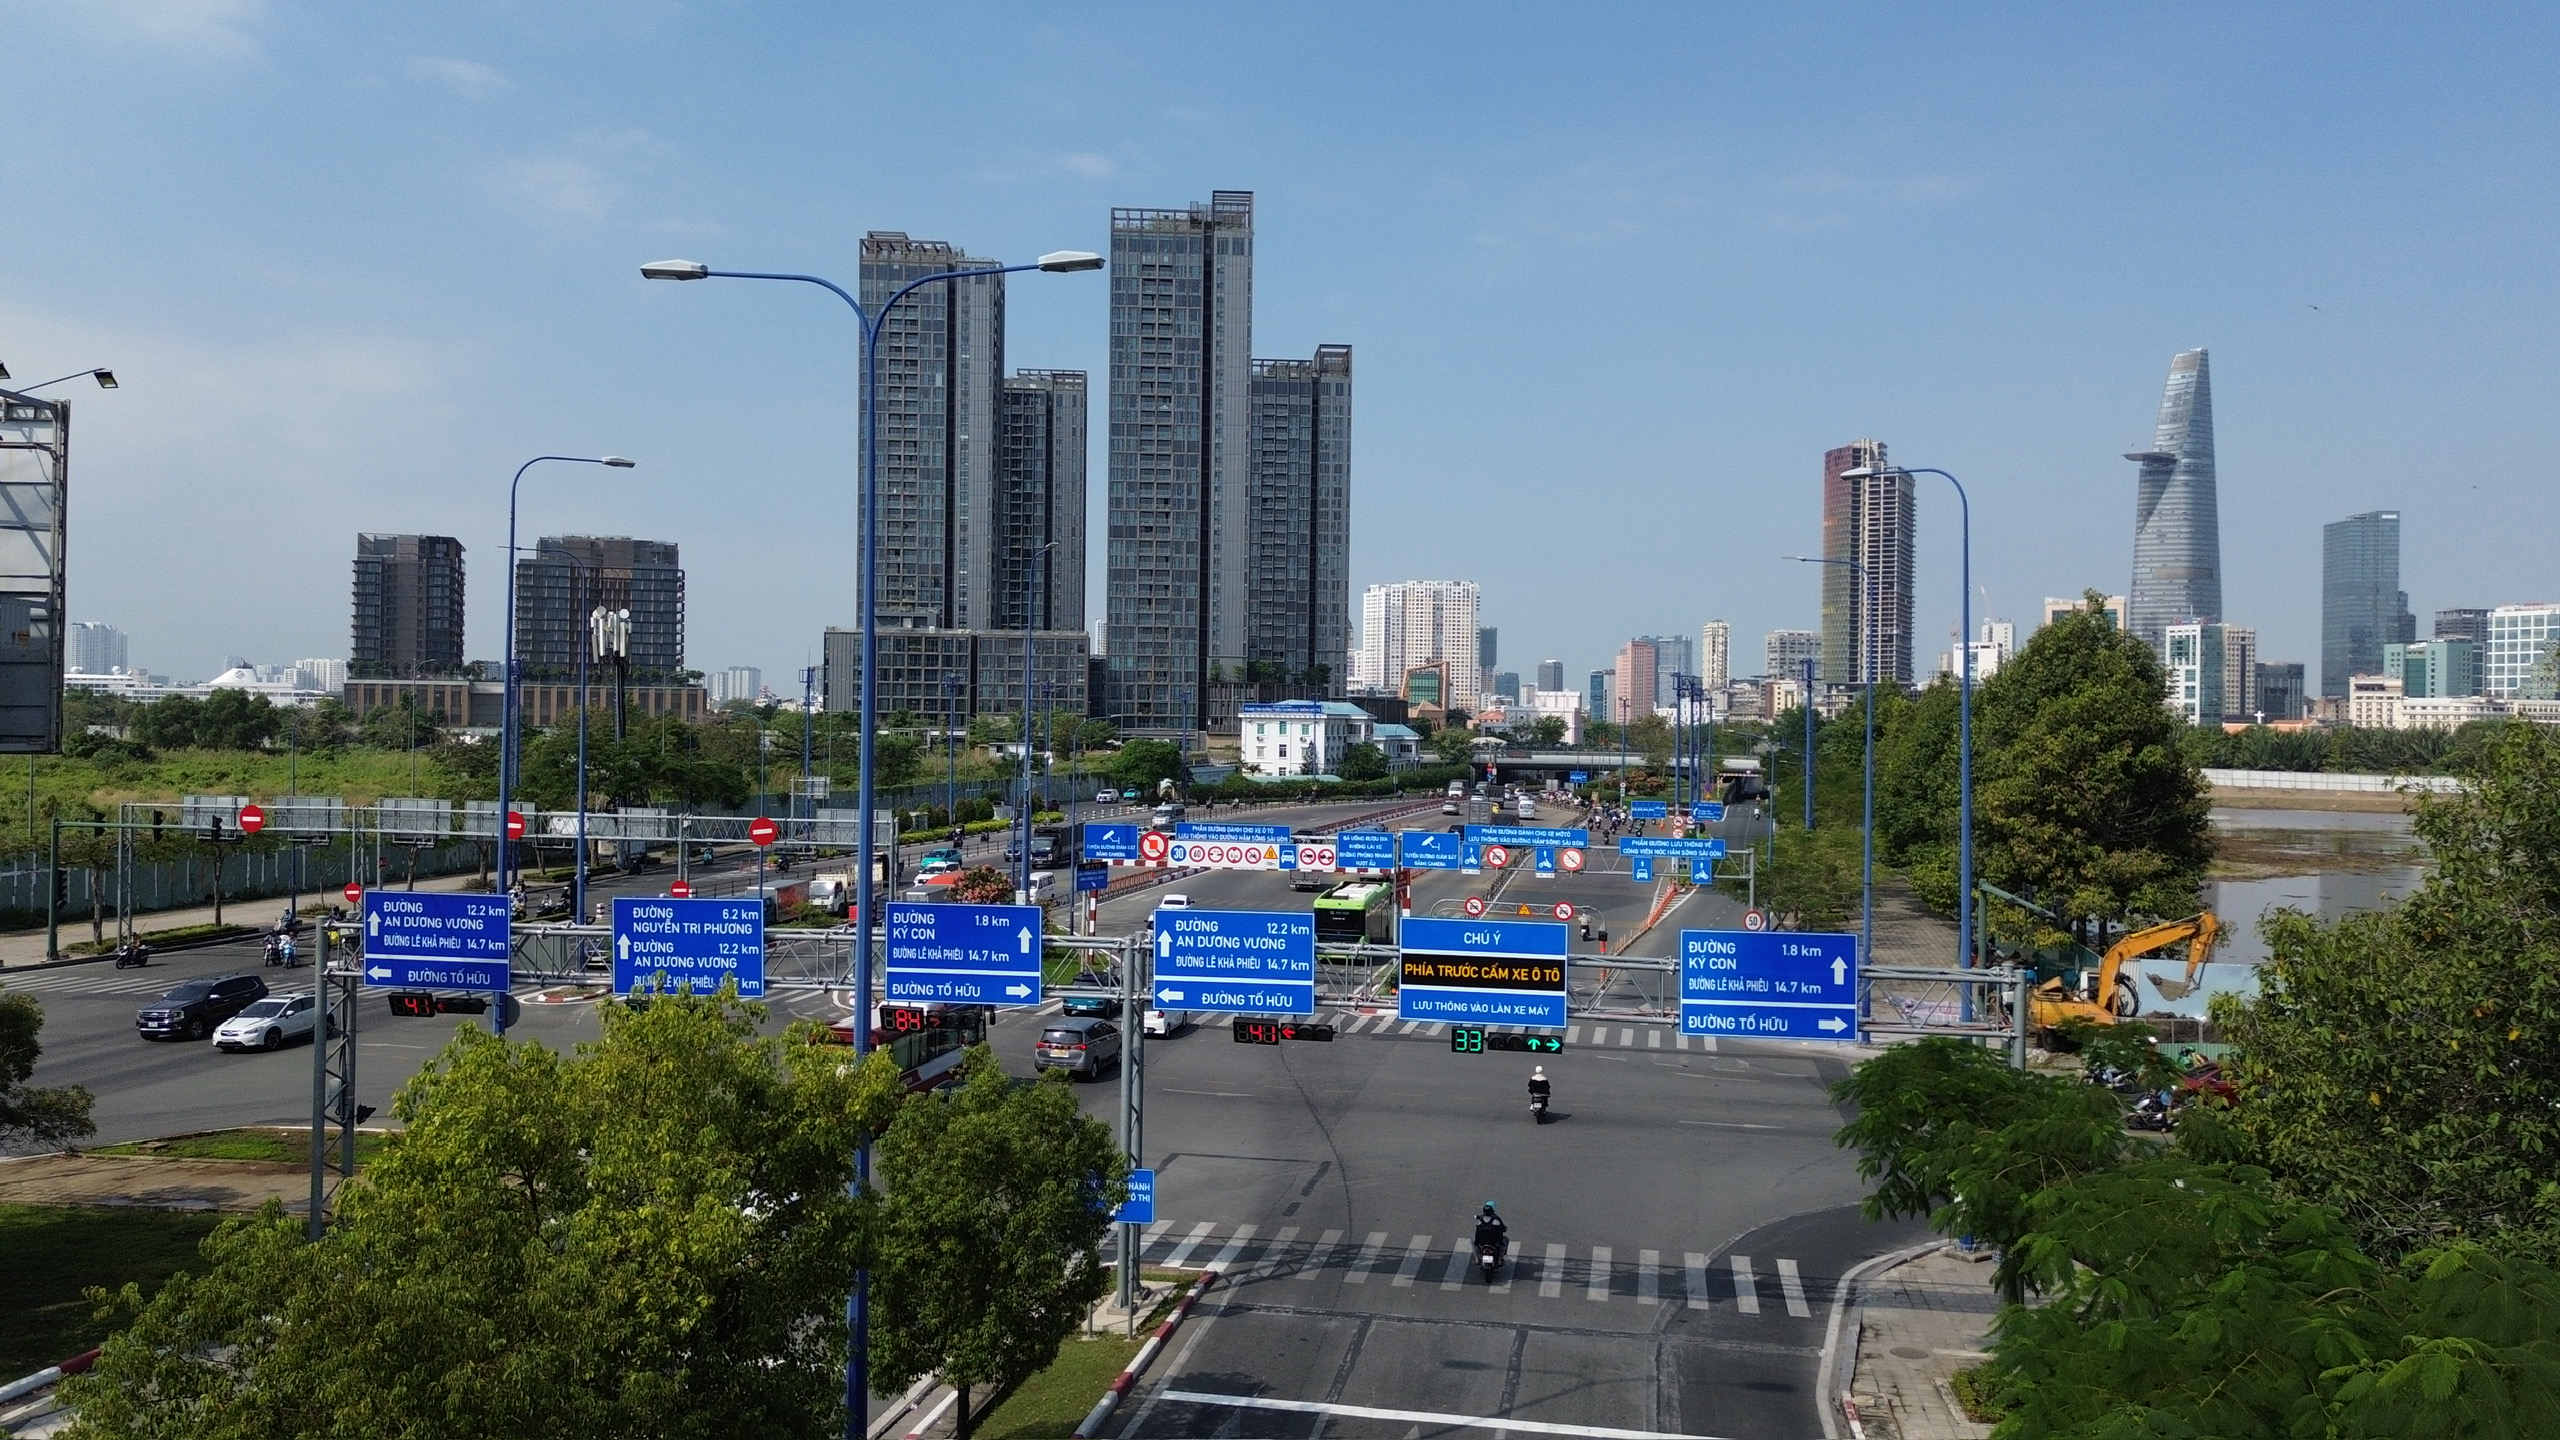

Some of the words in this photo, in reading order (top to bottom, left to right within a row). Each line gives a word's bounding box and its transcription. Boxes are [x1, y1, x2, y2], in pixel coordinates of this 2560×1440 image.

[1173, 848, 1184, 859] 30
[1194, 850, 1201, 858] 60
[384, 899, 423, 913] ĐƯỜNG
[467, 905, 486, 916] 12.2
[489, 906, 505, 916] km
[633, 905, 673, 918] ĐƯỜNG
[722, 909, 738, 920] 6.2
[741, 909, 759, 920] km
[893, 910, 935, 924] ĐƯỜNG
[975, 915, 989, 926] 1.8
[992, 916, 1010, 927] km
[1749, 916, 1757, 926] 50
[384, 917, 400, 927] AN
[404, 917, 442, 928] DƯƠNG
[446, 918, 484, 930] VƯƠNG
[633, 919, 679, 933] NGUYỄN
[683, 923, 700, 934] TRI
[704, 923, 752, 934] PHƯƠNG
[1176, 917, 1218, 932] ĐƯỜNG
[1266, 923, 1287, 934] 12.2
[1291, 923, 1309, 935] km
[893, 925, 907, 939] KÝ
[911, 928, 935, 940] CON
[1464, 929, 1489, 944] CHÚ
[1493, 930, 1501, 945] Ý
[384, 933, 409, 946] ĐƯỜNG
[412, 934, 420, 947] LÊ
[422, 934, 437, 948] KHẢ
[439, 935, 461, 949] PHIÊU
[467, 939, 486, 950] 14.7
[488, 940, 505, 950] km
[634, 939, 674, 953] ĐƯỜNG
[719, 944, 738, 954] 12.2
[741, 944, 759, 954] km
[1176, 936, 1194, 947] AN
[1198, 936, 1240, 948] DƯƠNG
[1243, 937, 1286, 950] VƯƠNG
[1688, 939, 1735, 954] ĐƯỜNG
[893, 945, 916, 959] ĐƯỜNG
[918, 946, 926, 960] LÊ
[928, 946, 942, 960] KHẢ
[944, 947, 963, 961] PHIÊU
[968, 950, 987, 961] 14.7
[992, 950, 1009, 962] km
[1782, 944, 1798, 956] 1.8
[1802, 945, 1821, 957] km
[634, 956, 650, 967] AN
[654, 957, 694, 968] DƯƠNG
[698, 957, 737, 968] VƯƠNG
[1176, 954, 1204, 968] ĐƯỜNG
[1206, 955, 1216, 968] LÊ
[1218, 954, 1235, 968] KHẢ
[1236, 956, 1260, 969] PHIÊU
[1266, 959, 1288, 970] 14.7
[1291, 959, 1309, 971] km
[1689, 955, 1705, 969] KÝ
[1710, 958, 1736, 970] CON
[408, 968, 447, 983] ĐƯỜNG
[450, 968, 464, 983] TỐ
[467, 970, 490, 984] HỮU
[1404, 962, 1434, 976] PHÍA
[1437, 962, 1479, 978] TRƯỚC
[1481, 962, 1508, 979] CẤM
[1512, 969, 1528, 980] XE
[1532, 967, 1540, 981] Ô
[1544, 968, 1560, 982] TÔ
[691, 975, 713, 988] PHIÊU
[742, 978, 759, 989] km
[892, 981, 934, 996] ĐƯỜNG
[937, 981, 952, 996] TỐ
[955, 982, 980, 997] HỮU
[1689, 975, 1715, 990] ĐƯỜNG
[1717, 976, 1726, 991] LÊ
[1729, 976, 1744, 991] KHẢ
[1746, 978, 1768, 992] PHIÊU
[1775, 981, 1797, 993] 14.7
[1802, 982, 1821, 994] km
[405, 998, 429, 1014] 41
[1202, 990, 1244, 1005] ĐƯỜNG
[1248, 990, 1264, 1006] TỐ
[1266, 992, 1292, 1007] HỮU
[1413, 1001, 1432, 1010] LƯU
[1435, 1000, 1468, 1012] THÔNG
[1470, 1001, 1488, 1013] VÀO
[1491, 1003, 1511, 1014] LÀN
[1514, 1005, 1526, 1015] XE
[1528, 1003, 1549, 1015] MÁY
[895, 1010, 921, 1030] 84
[1688, 1013, 1735, 1029] ĐƯỜNG
[1739, 1013, 1756, 1030] TỐ
[1760, 1015, 1788, 1031] HỮU
[1249, 1024, 1276, 1042] 41
[1456, 1030, 1481, 1051] 33
[1138, 1194, 1150, 1203] THỊ
